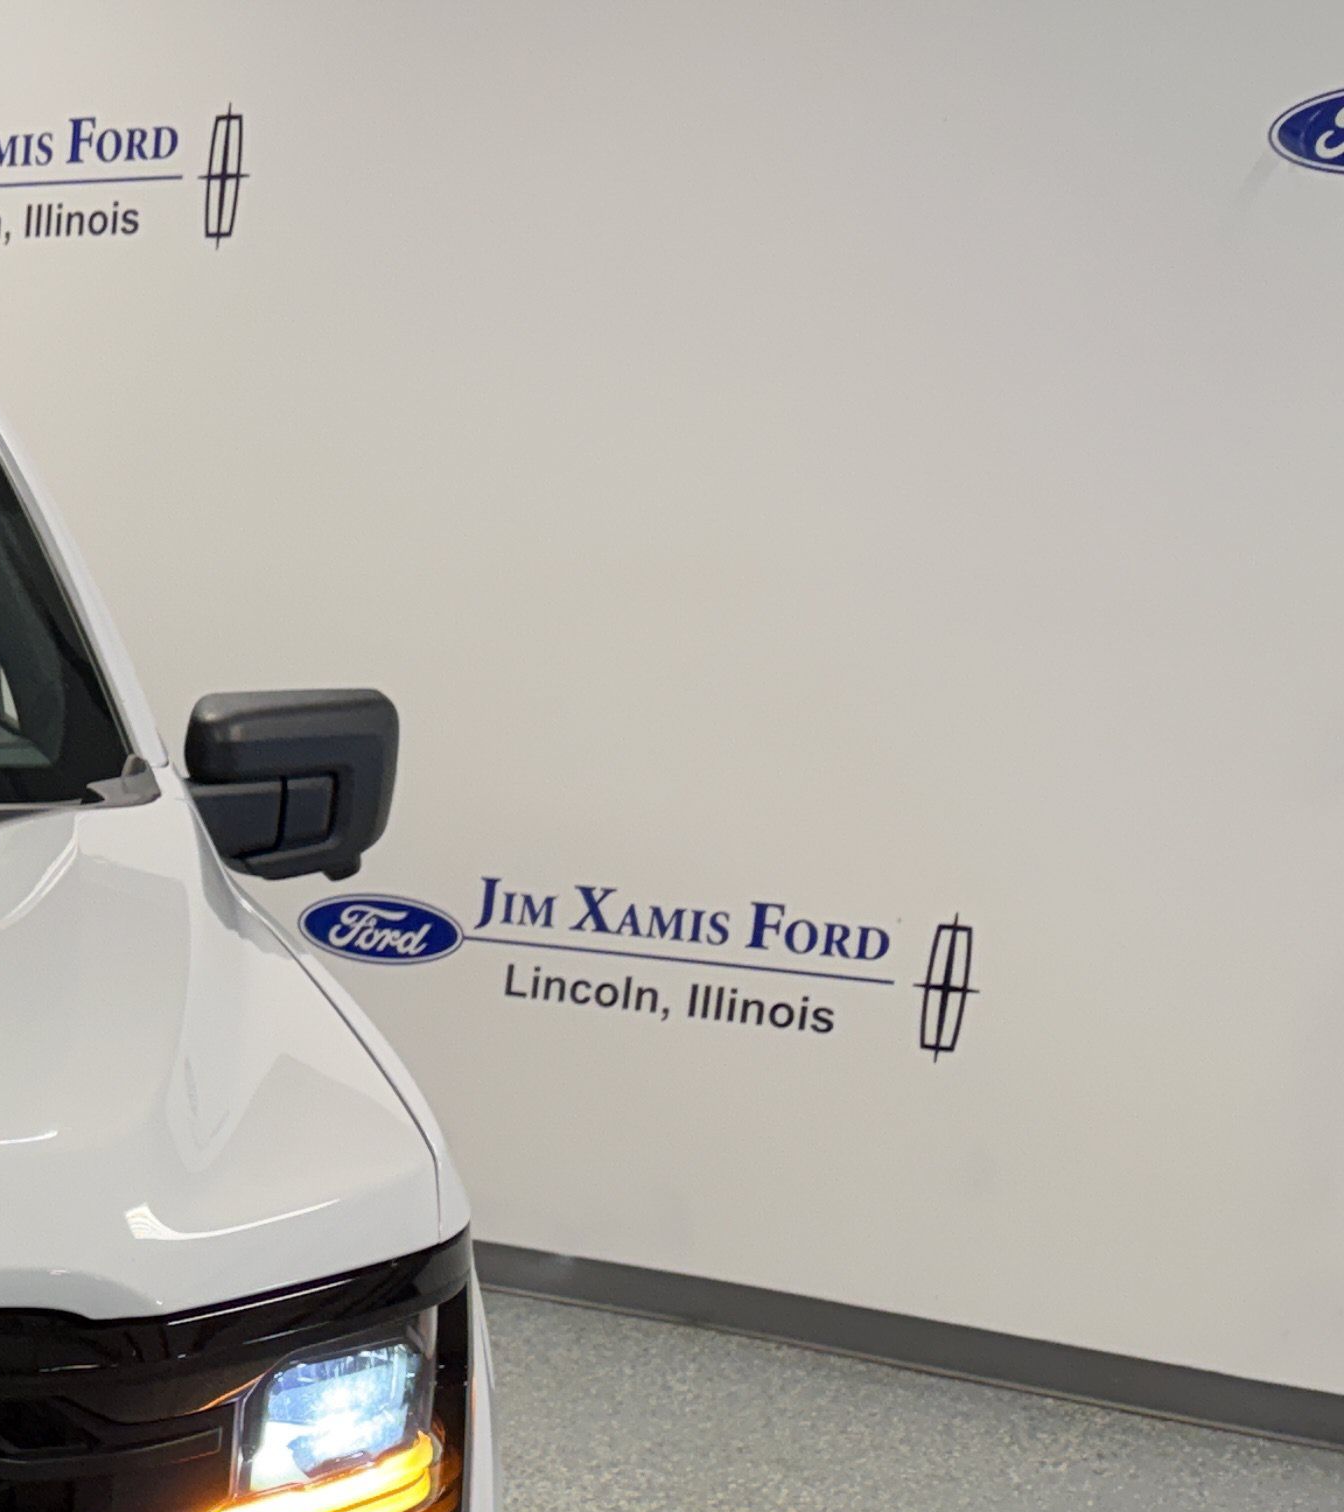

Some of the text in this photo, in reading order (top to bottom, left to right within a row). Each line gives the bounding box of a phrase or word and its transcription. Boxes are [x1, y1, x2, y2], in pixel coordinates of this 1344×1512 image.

[67, 117, 178, 164] FORD
[25, 202, 139, 238] Illinois
[329, 904, 426, 956] Ford
[474, 877, 890, 961] JIM XAMIS FORD
[504, 964, 834, 1034] Lincoln, Illinois
